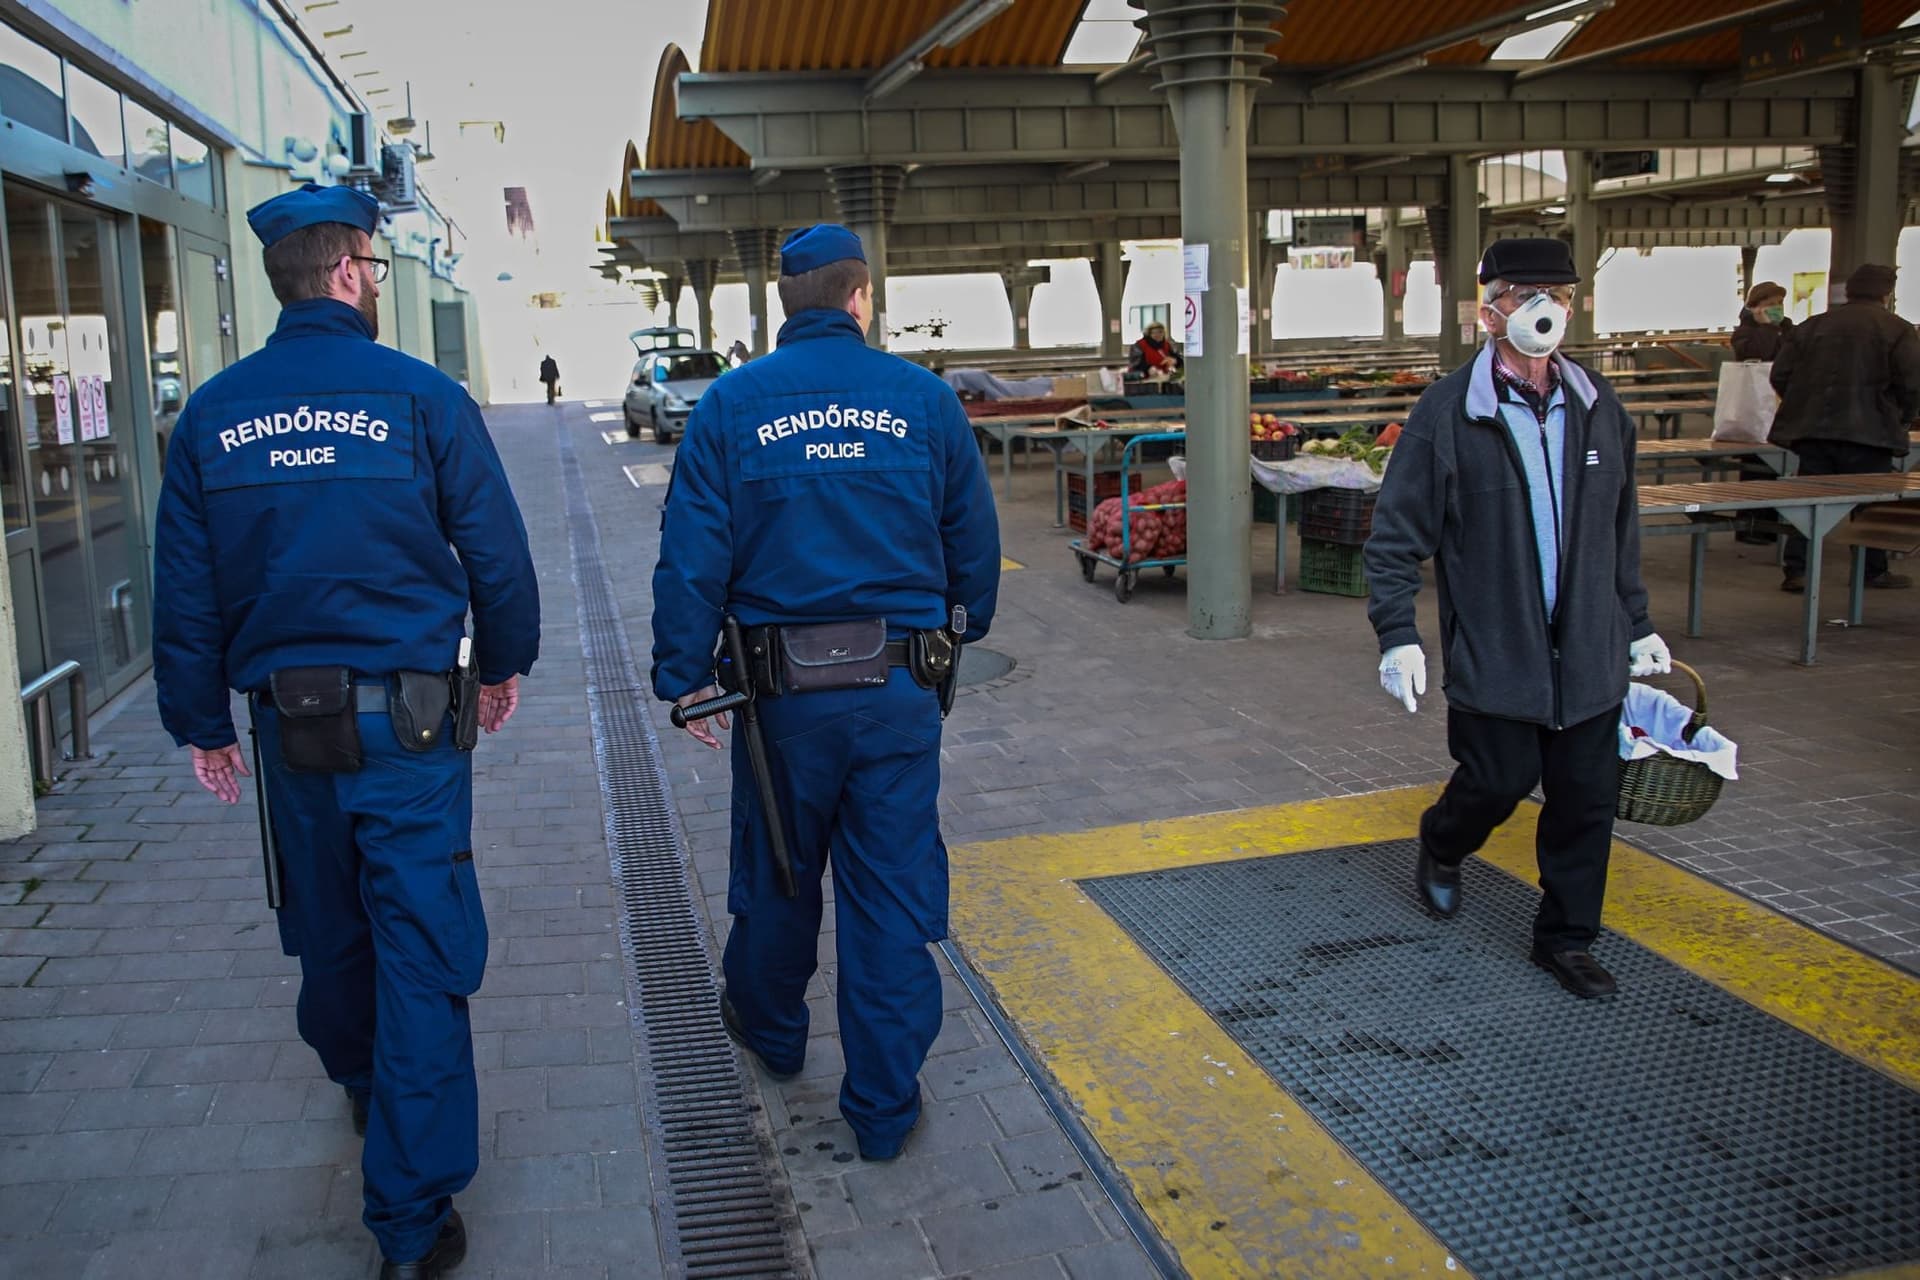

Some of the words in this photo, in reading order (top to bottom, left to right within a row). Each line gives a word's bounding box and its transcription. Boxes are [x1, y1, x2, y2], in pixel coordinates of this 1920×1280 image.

[219, 406, 389, 452] RENDŐRSÉG
[758, 404, 908, 446] RENDŐRSÉG
[270, 446, 336, 467] POLICE
[805, 442, 866, 460] POLICE
